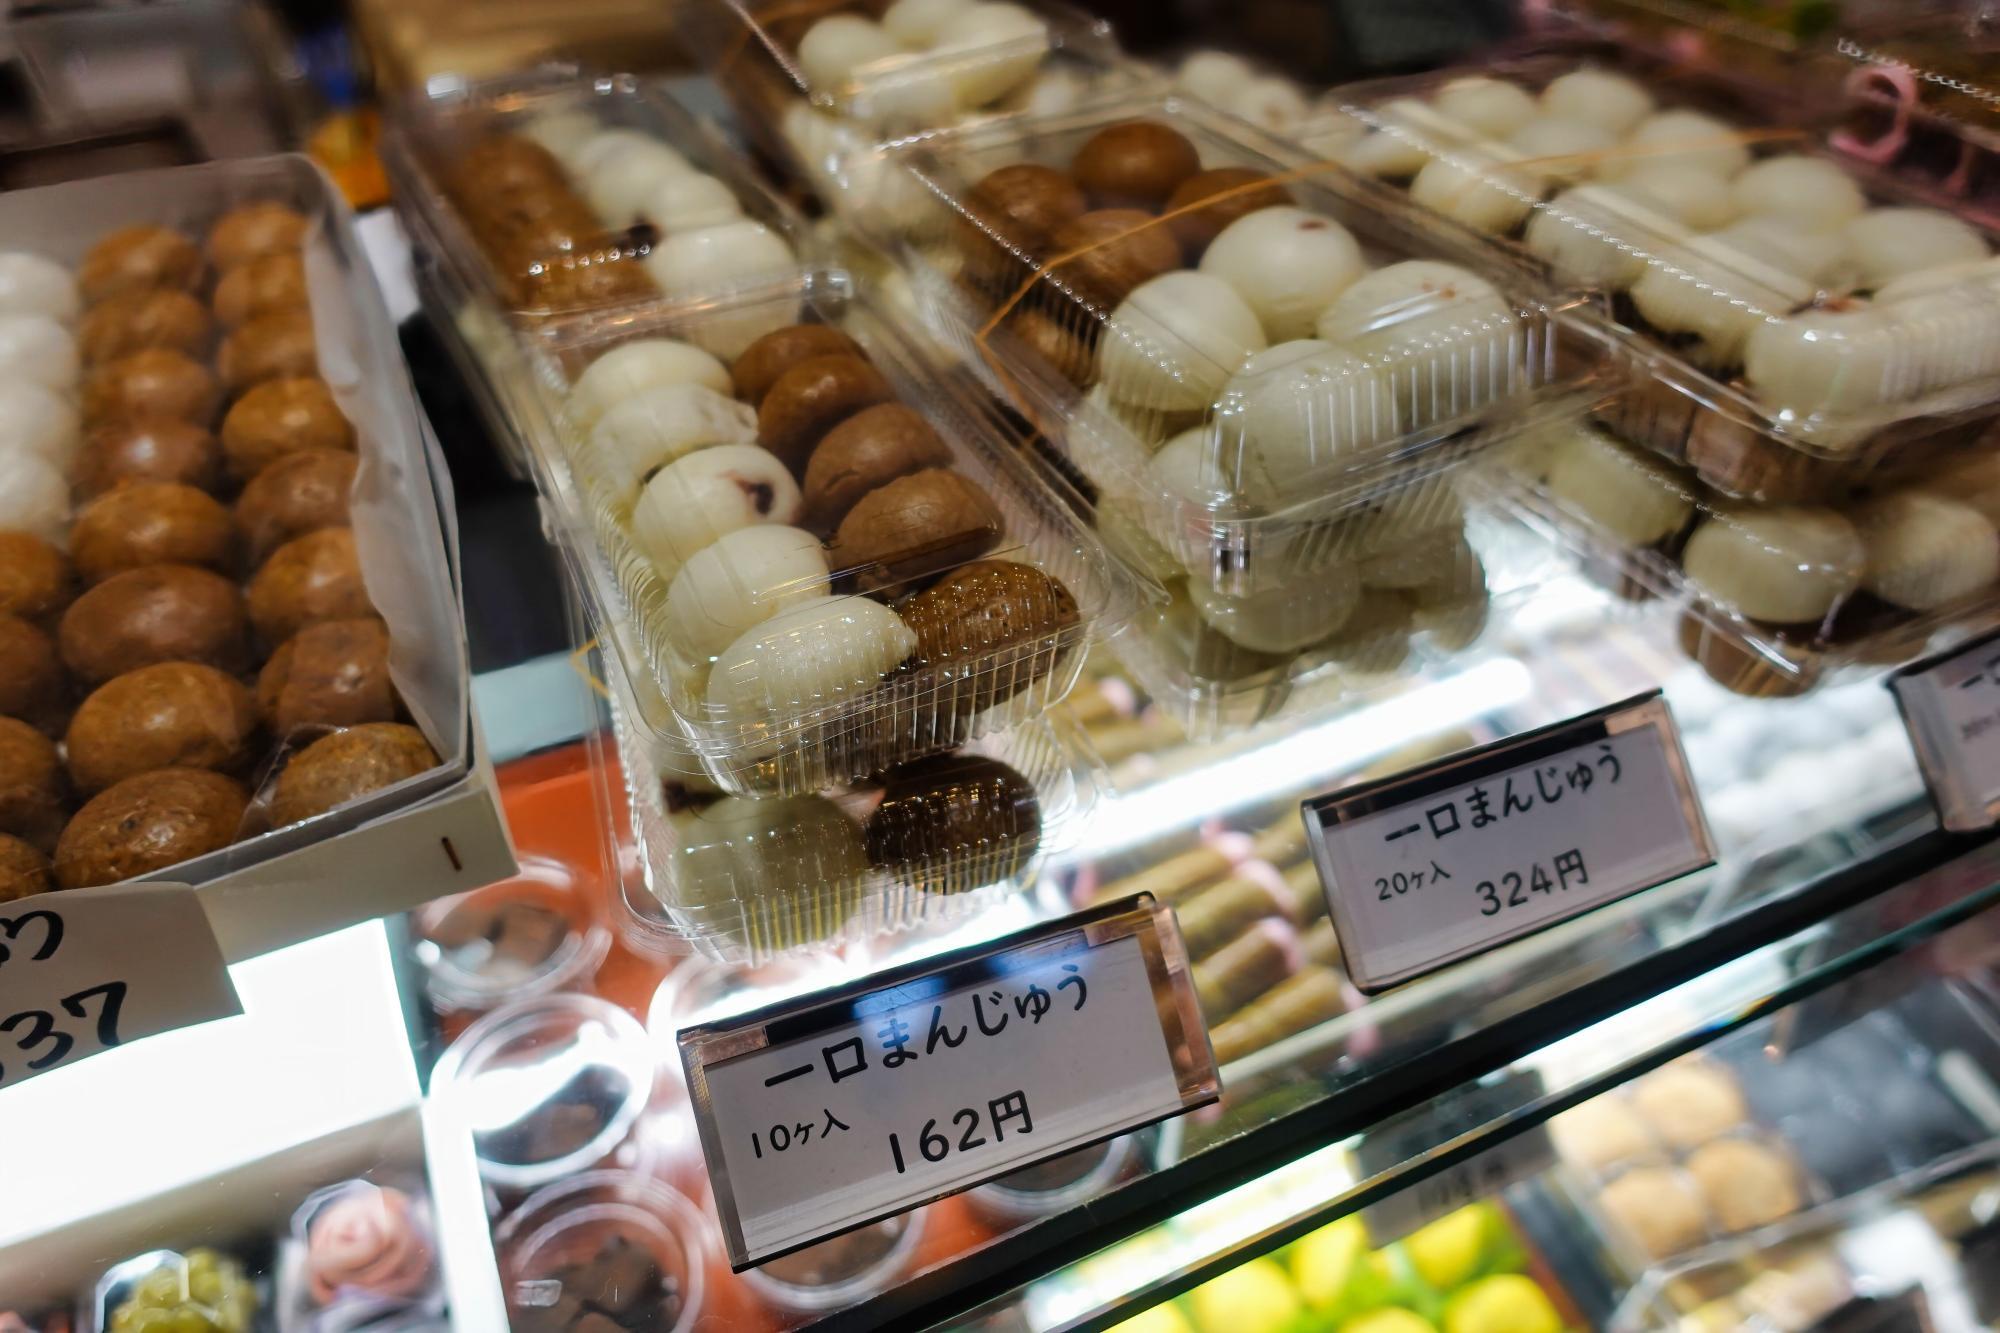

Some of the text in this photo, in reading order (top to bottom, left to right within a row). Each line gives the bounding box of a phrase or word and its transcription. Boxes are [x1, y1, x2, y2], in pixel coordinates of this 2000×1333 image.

[1384, 745, 1622, 842] 一口まんじゅう
[1475, 848, 1589, 917] 324円
[0, 981, 127, 1082] 37
[764, 963, 1088, 1088] 一口まんじゅう
[889, 1089, 1034, 1174] 162円
